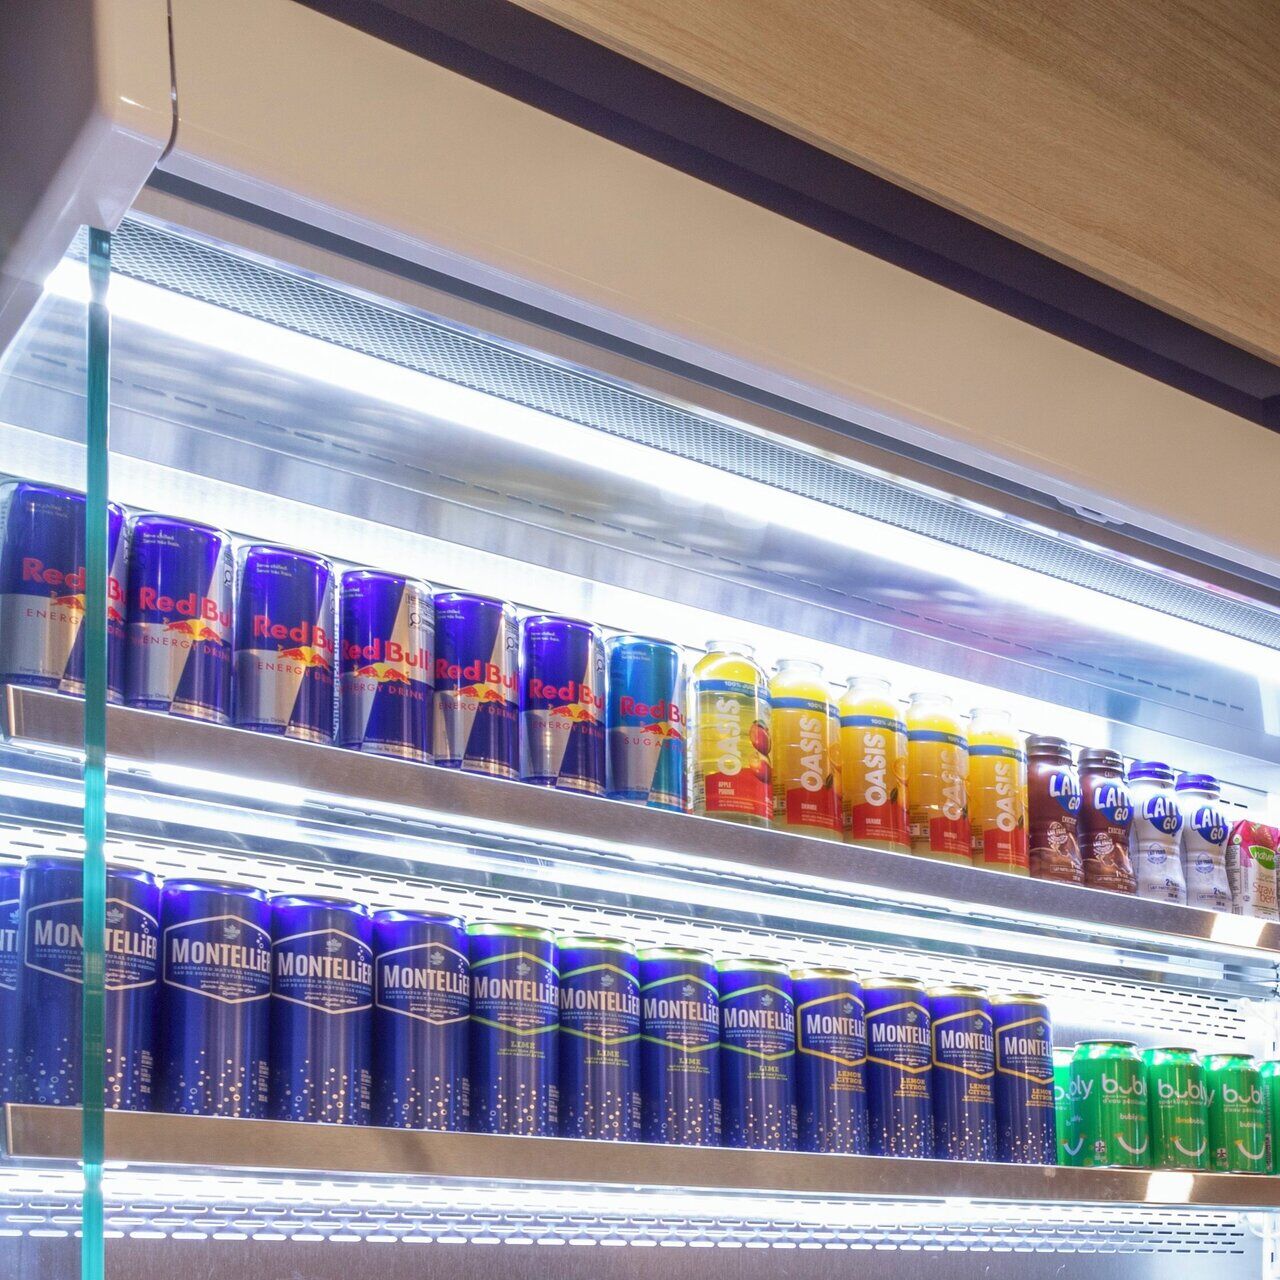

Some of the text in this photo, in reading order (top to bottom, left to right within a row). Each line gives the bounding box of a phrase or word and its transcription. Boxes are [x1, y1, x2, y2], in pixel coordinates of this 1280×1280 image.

[22, 556, 86, 592] Red
[139, 586, 196, 617] Red
[254, 614, 308, 643] Red
[385, 641, 430, 672] Bull
[435, 658, 481, 682] Red
[388, 685, 424, 702] DRINK
[529, 678, 575, 701] Red
[620, 696, 664, 720] Red
[717, 696, 743, 777] OASIS
[800, 713, 823, 793] OASIS
[863, 732, 887, 808] OASIS
[996, 760, 1017, 832] OASIS
[1114, 806, 1129, 822] GO
[1163, 816, 1177, 831] GO
[1210, 826, 1223, 841] GO
[172, 938, 271, 972] MONTELLiER
[277, 951, 373, 984] MONTELLiER
[474, 977, 559, 1007] MONTELLiER
[560, 987, 640, 1016] MONTELLiER
[644, 998, 719, 1024] MONTELLiER
[1158, 1078, 1216, 1107] bubly
